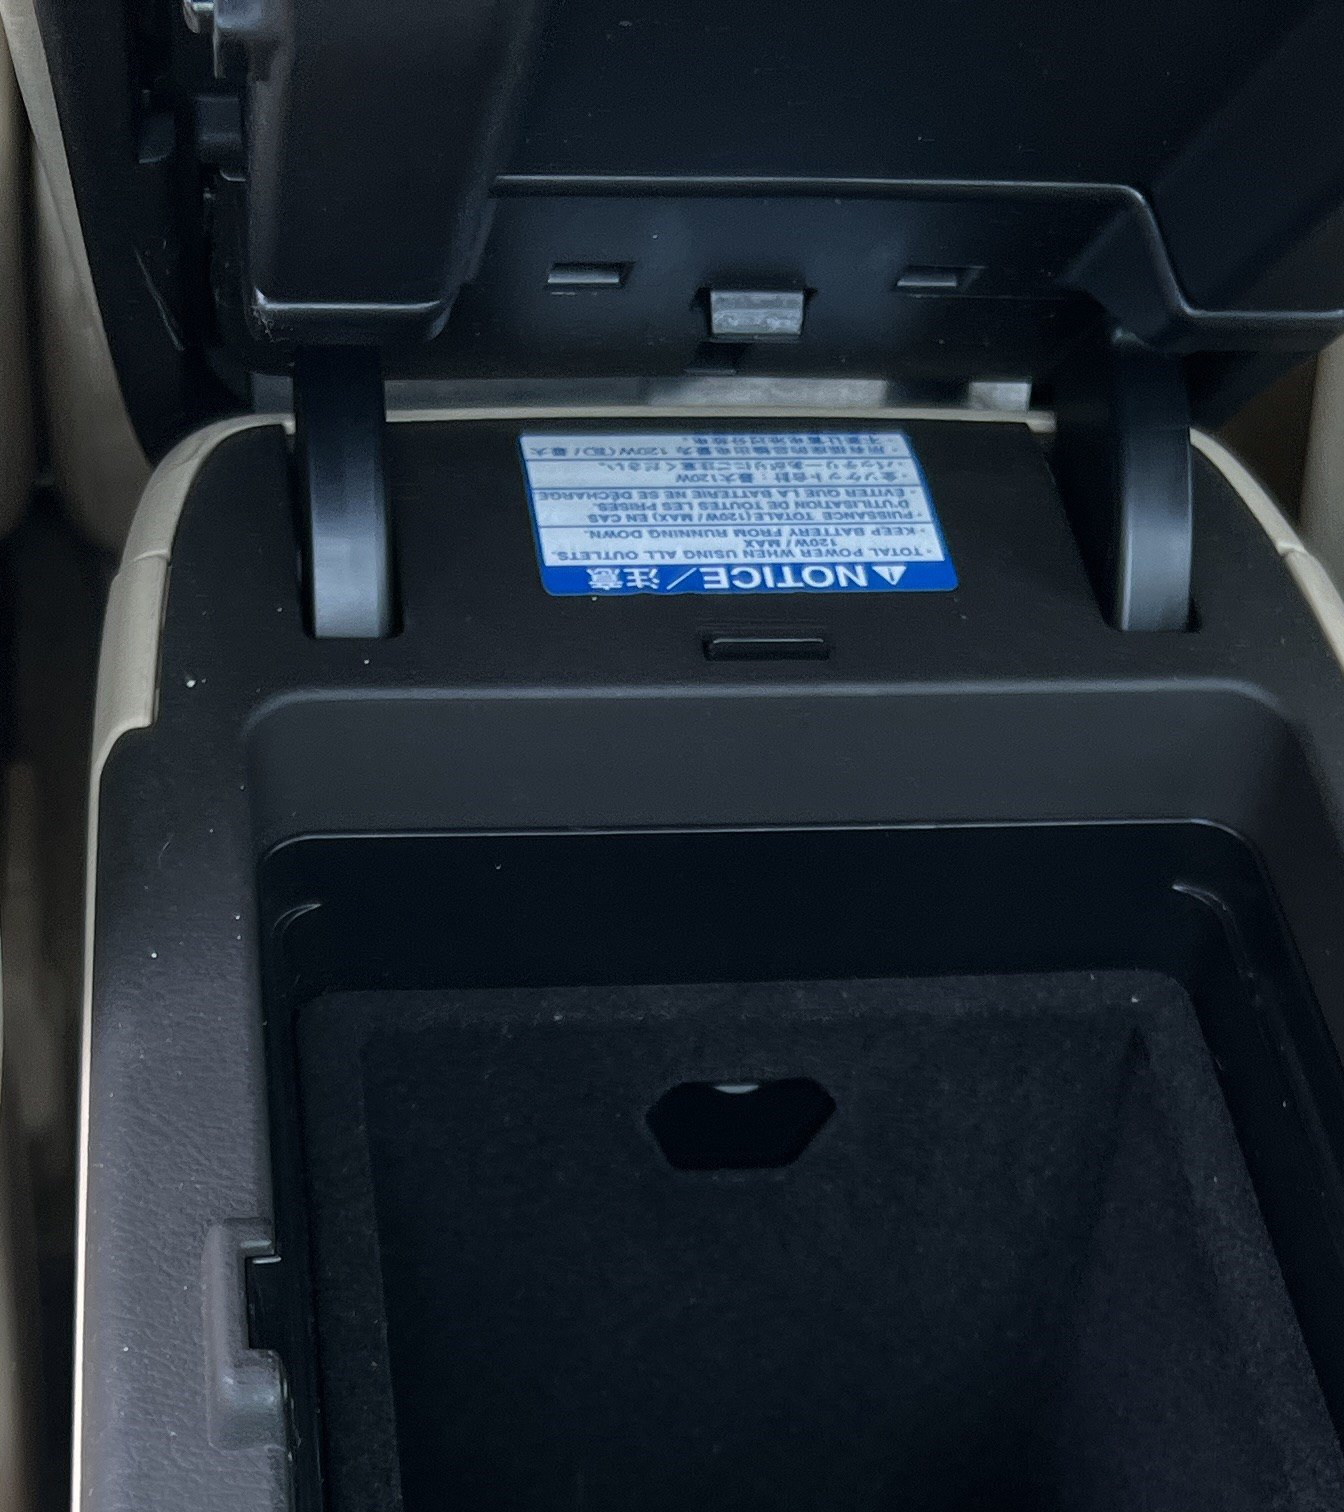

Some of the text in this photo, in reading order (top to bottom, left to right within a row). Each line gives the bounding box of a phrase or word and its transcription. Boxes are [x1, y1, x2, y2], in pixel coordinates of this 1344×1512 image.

[637, 491, 659, 500] SE
[664, 491, 687, 499] NE
[692, 490, 772, 499] BATTERIE
[776, 489, 799, 498] LA
[804, 489, 841, 498] QUE
[661, 502, 693, 511] LES
[698, 502, 763, 511] TOUTES
[767, 501, 790, 510] DE
[588, 514, 622, 523] CAS
[626, 514, 648, 523] EN
[822, 511, 913, 520] PUISSANCE
[647, 529, 728, 538] RUNNING
[733, 528, 782, 537] FROM
[789, 527, 864, 537] BATTERY
[870, 526, 916, 536] KEEP
[643, 550, 677, 560] ALL
[683, 550, 737, 559] USING
[742, 549, 795, 559] WHEN
[801, 548, 863, 558] POWER
[869, 547, 923, 557] TOTAL
